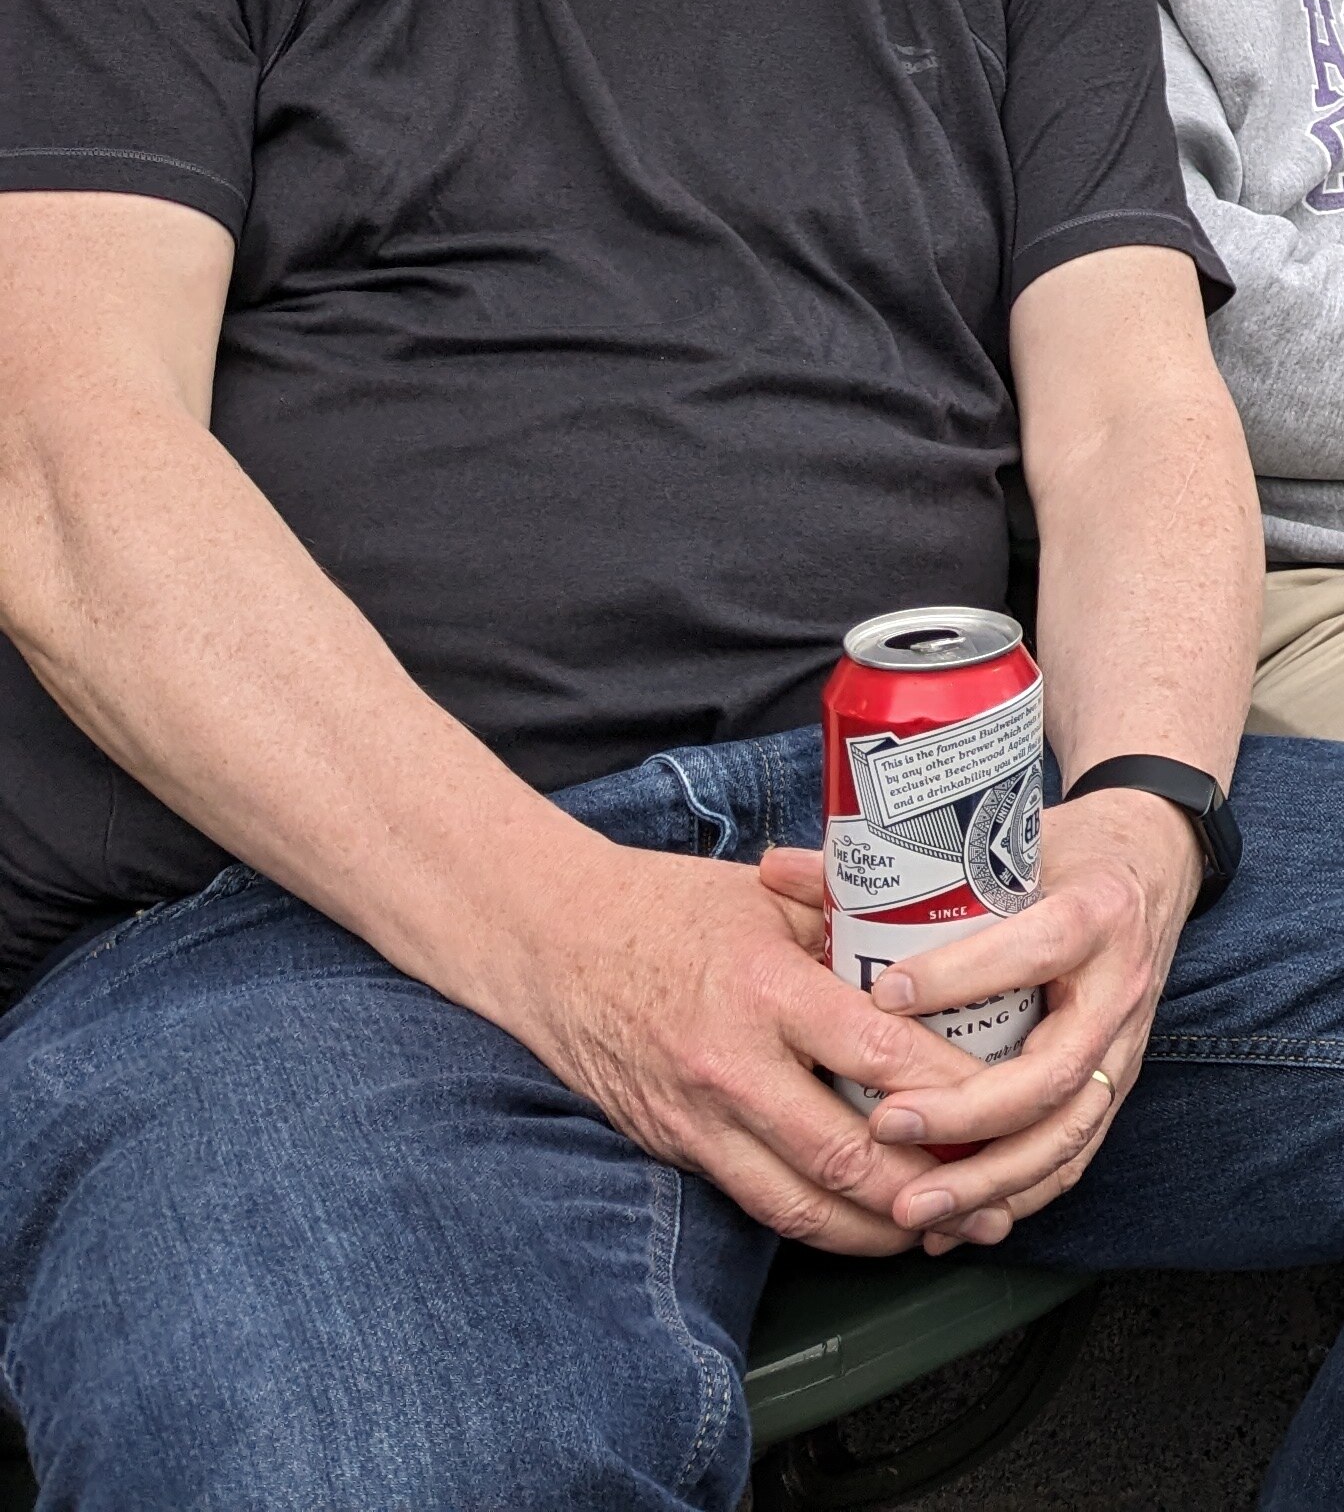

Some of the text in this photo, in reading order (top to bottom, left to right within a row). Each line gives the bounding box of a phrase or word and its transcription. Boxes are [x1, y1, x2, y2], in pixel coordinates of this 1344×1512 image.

[881, 759, 903, 772] This
[905, 755, 914, 765] is
[917, 749, 934, 761] the
[936, 734, 977, 756] famous
[979, 713, 1025, 739] Budweiser
[885, 773, 899, 785] by
[902, 766, 922, 780] any
[925, 755, 955, 772] other
[959, 739, 995, 760] brewer
[998, 726, 1022, 744] which
[890, 774, 941, 797] exclusive
[945, 747, 1005, 778] Beechwood
[894, 797, 914, 810] and
[917, 794, 924, 802] a
[927, 768, 992, 799] drinkability
[994, 759, 1011, 776] you
[1013, 746, 1026, 762] will
[996, 792, 1017, 824] UNITED
[832, 839, 896, 870] THE GREAT
[836, 864, 901, 895] AMERICAN
[929, 906, 968, 920] SINCE
[946, 1010, 1010, 1038] KING
